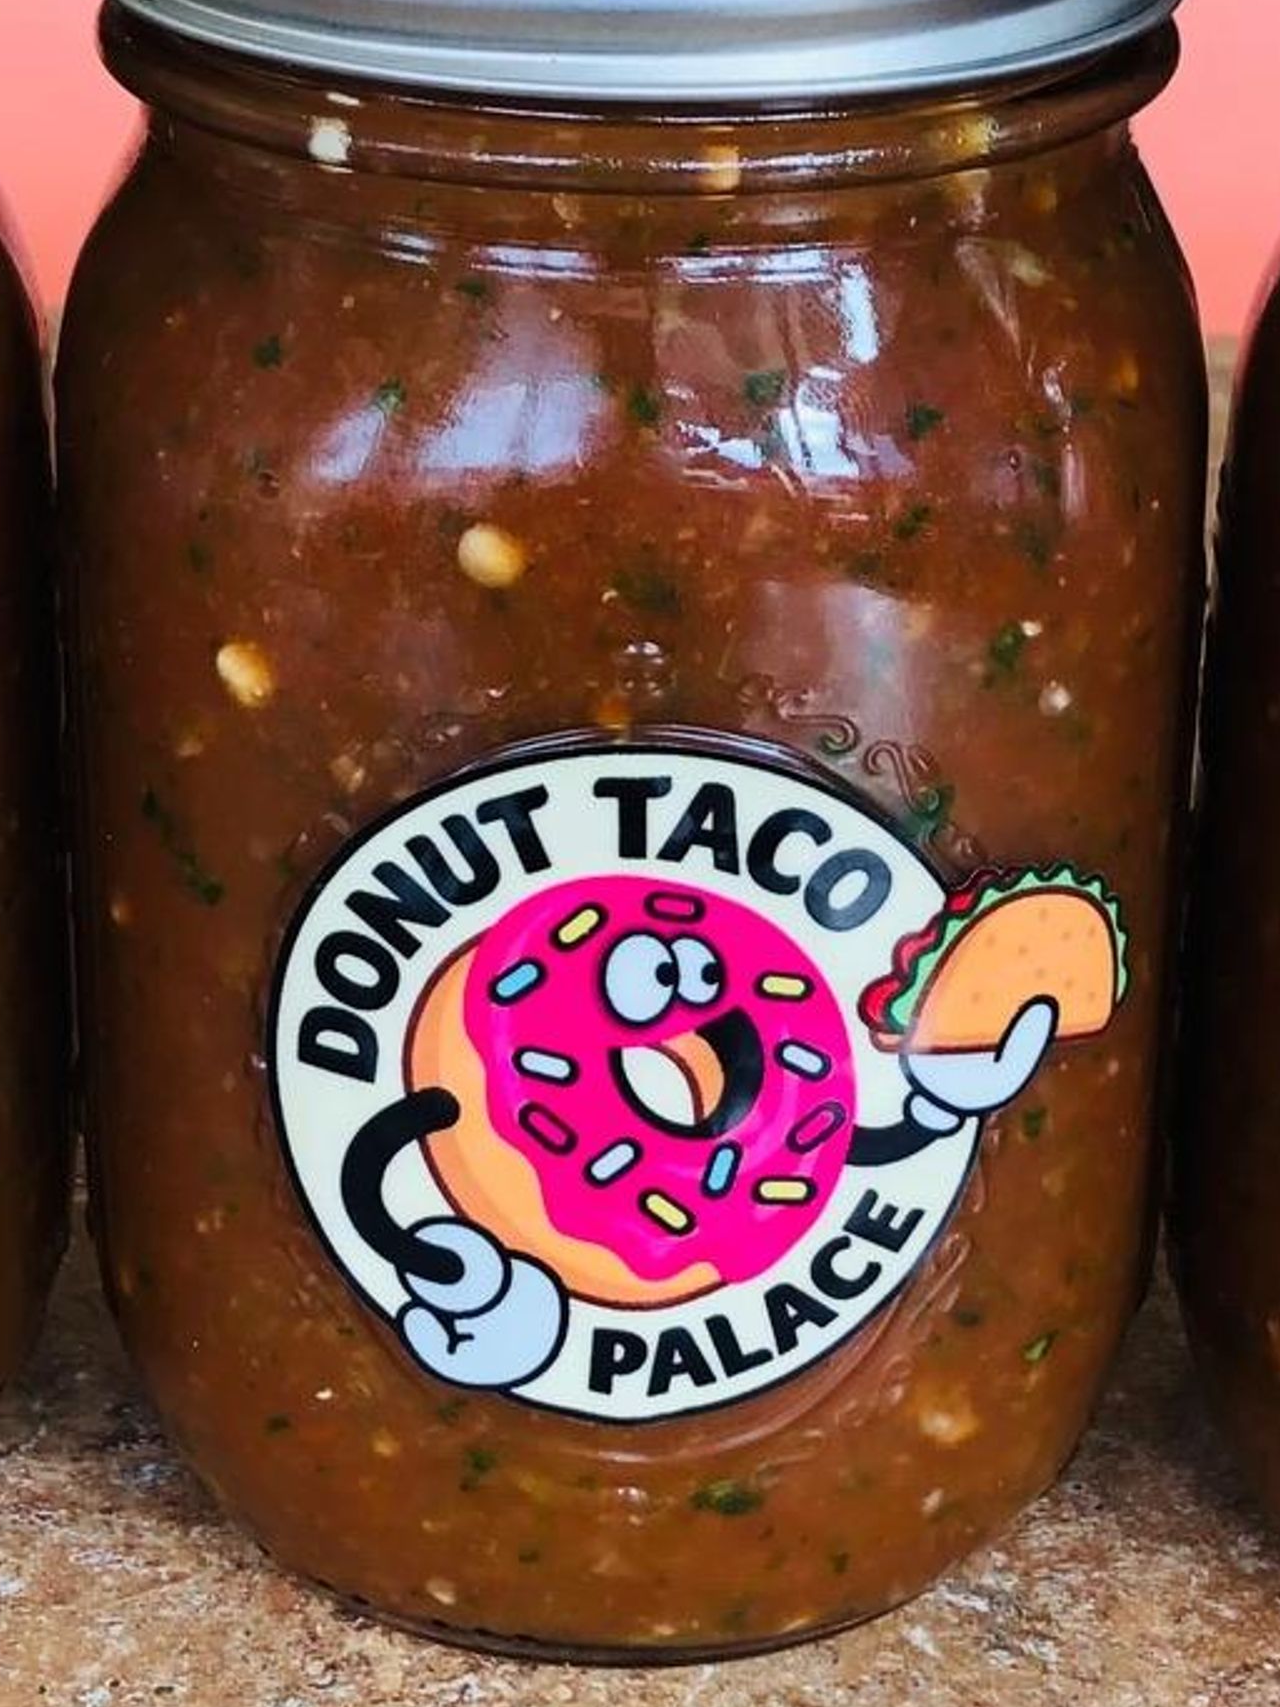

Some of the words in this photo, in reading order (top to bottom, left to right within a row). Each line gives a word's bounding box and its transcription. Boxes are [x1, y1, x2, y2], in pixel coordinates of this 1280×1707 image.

[297, 785, 550, 1082] DONUT
[593, 776, 892, 932] TACO
[587, 1189, 925, 1397] PALACE
